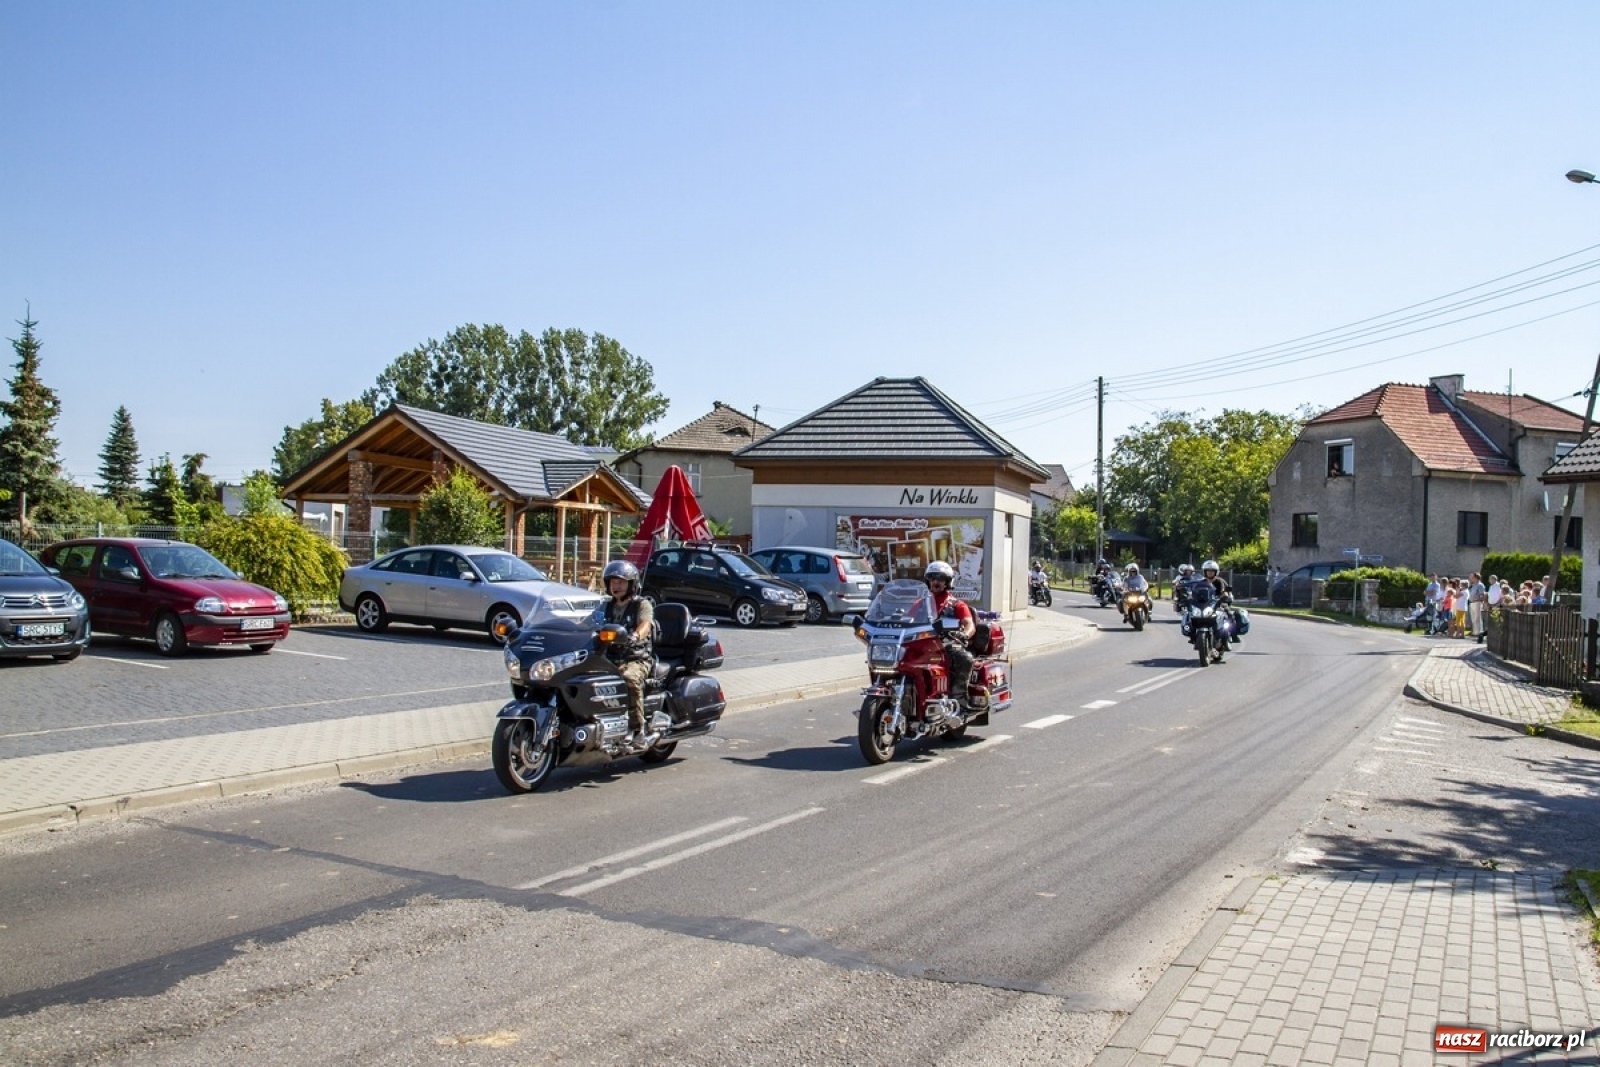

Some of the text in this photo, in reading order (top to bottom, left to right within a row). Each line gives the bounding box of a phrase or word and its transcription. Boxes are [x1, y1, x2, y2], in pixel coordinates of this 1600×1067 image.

[899, 488, 979, 506] Na Winklu
[23, 624, 42, 635] SRC
